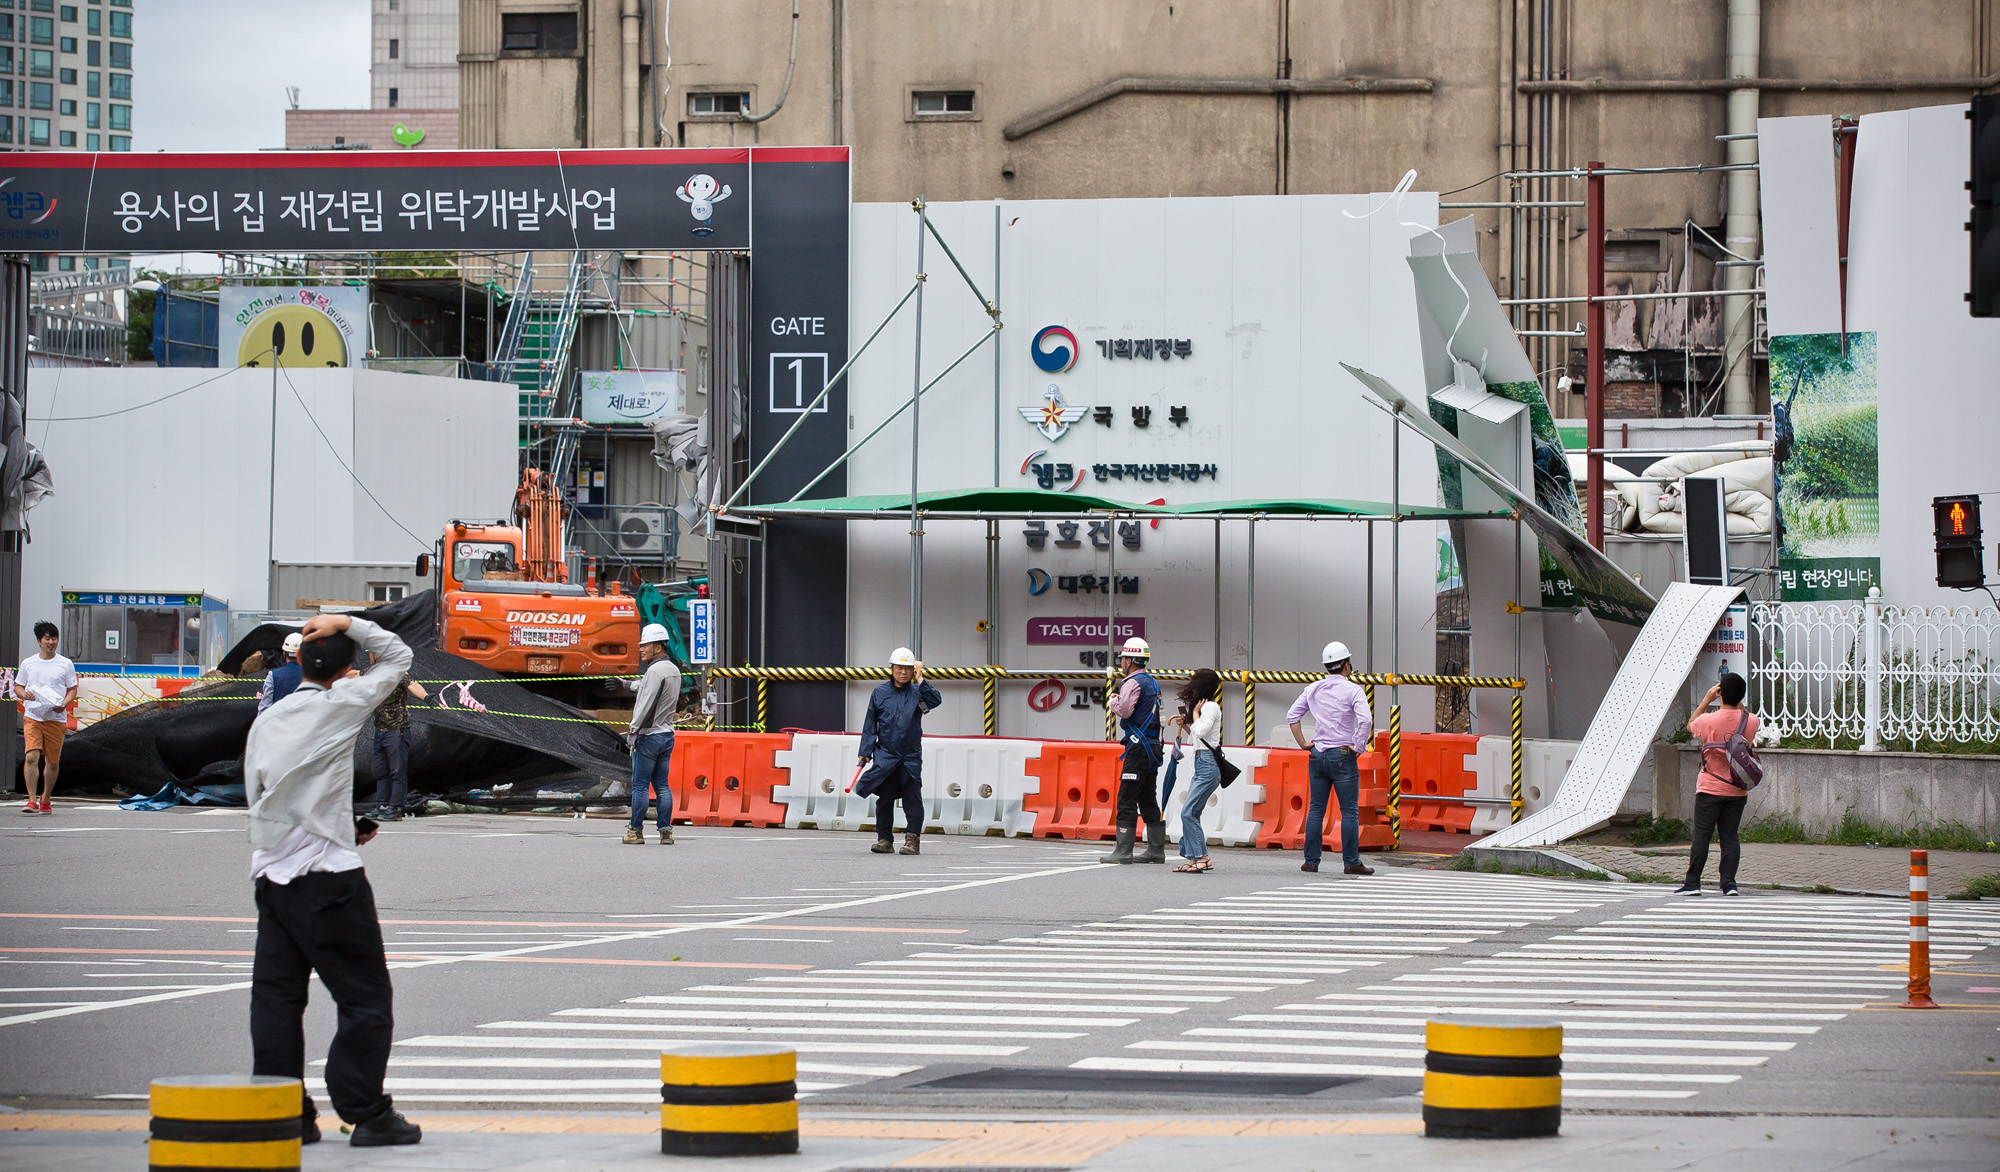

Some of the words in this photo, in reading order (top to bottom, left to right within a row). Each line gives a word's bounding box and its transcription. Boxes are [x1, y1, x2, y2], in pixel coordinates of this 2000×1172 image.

[0, 191, 44, 220] 캠코
[113, 190, 220, 234] 용사의
[233, 190, 264, 233] 집
[280, 190, 383, 232] 재건립
[398, 187, 616, 232] 위탁개발사업
[770, 316, 825, 335] GATE
[1095, 338, 1193, 361] 기획재정부
[587, 375, 617, 391] 安全
[788, 358, 803, 407] 1
[607, 394, 651, 411] 제대로!
[1031, 463, 1074, 490] 캠코
[1091, 463, 1218, 482] 한국자산관리공사
[1022, 520, 1142, 549] 금호건설
[1058, 575, 1139, 595] 대우건설
[1801, 568, 1876, 589] 현장입니다.
[118, 595, 166, 605] 안전교육장
[506, 611, 586, 625] DOOSAN
[1038, 624, 1134, 637] TAEYOUNG
[1718, 643, 1745, 653] 죄송합니다
